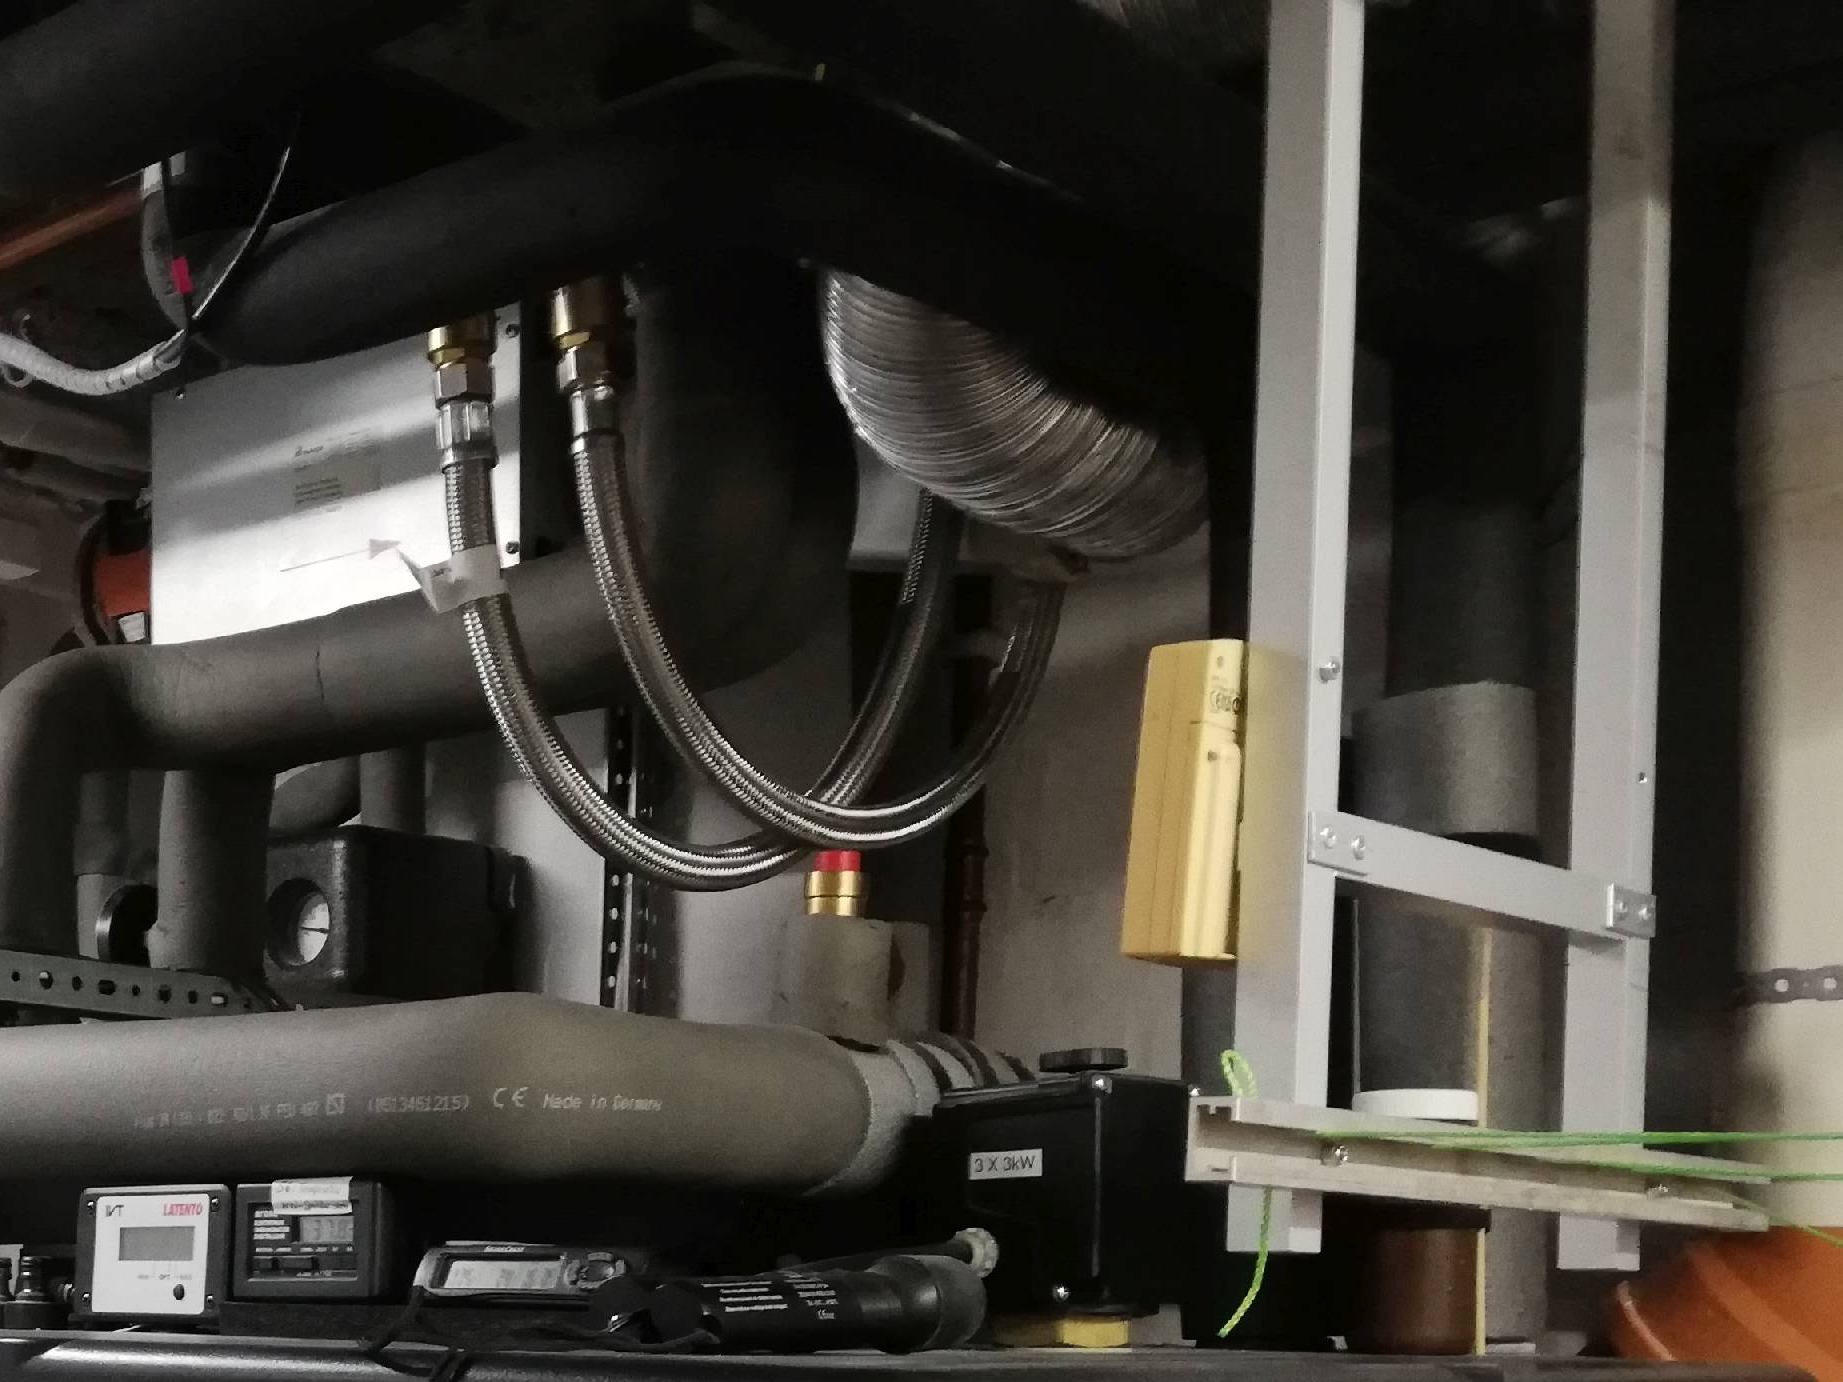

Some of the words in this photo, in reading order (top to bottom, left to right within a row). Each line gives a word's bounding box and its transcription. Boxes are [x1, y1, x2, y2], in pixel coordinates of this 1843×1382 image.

[541, 1092, 583, 1111] Made
[590, 1093, 608, 1110] in
[612, 1094, 663, 1112] Germany
[974, 1157, 984, 1173] 3
[1003, 1154, 1037, 1172] 3kW
[162, 1202, 204, 1217] LATENTO
